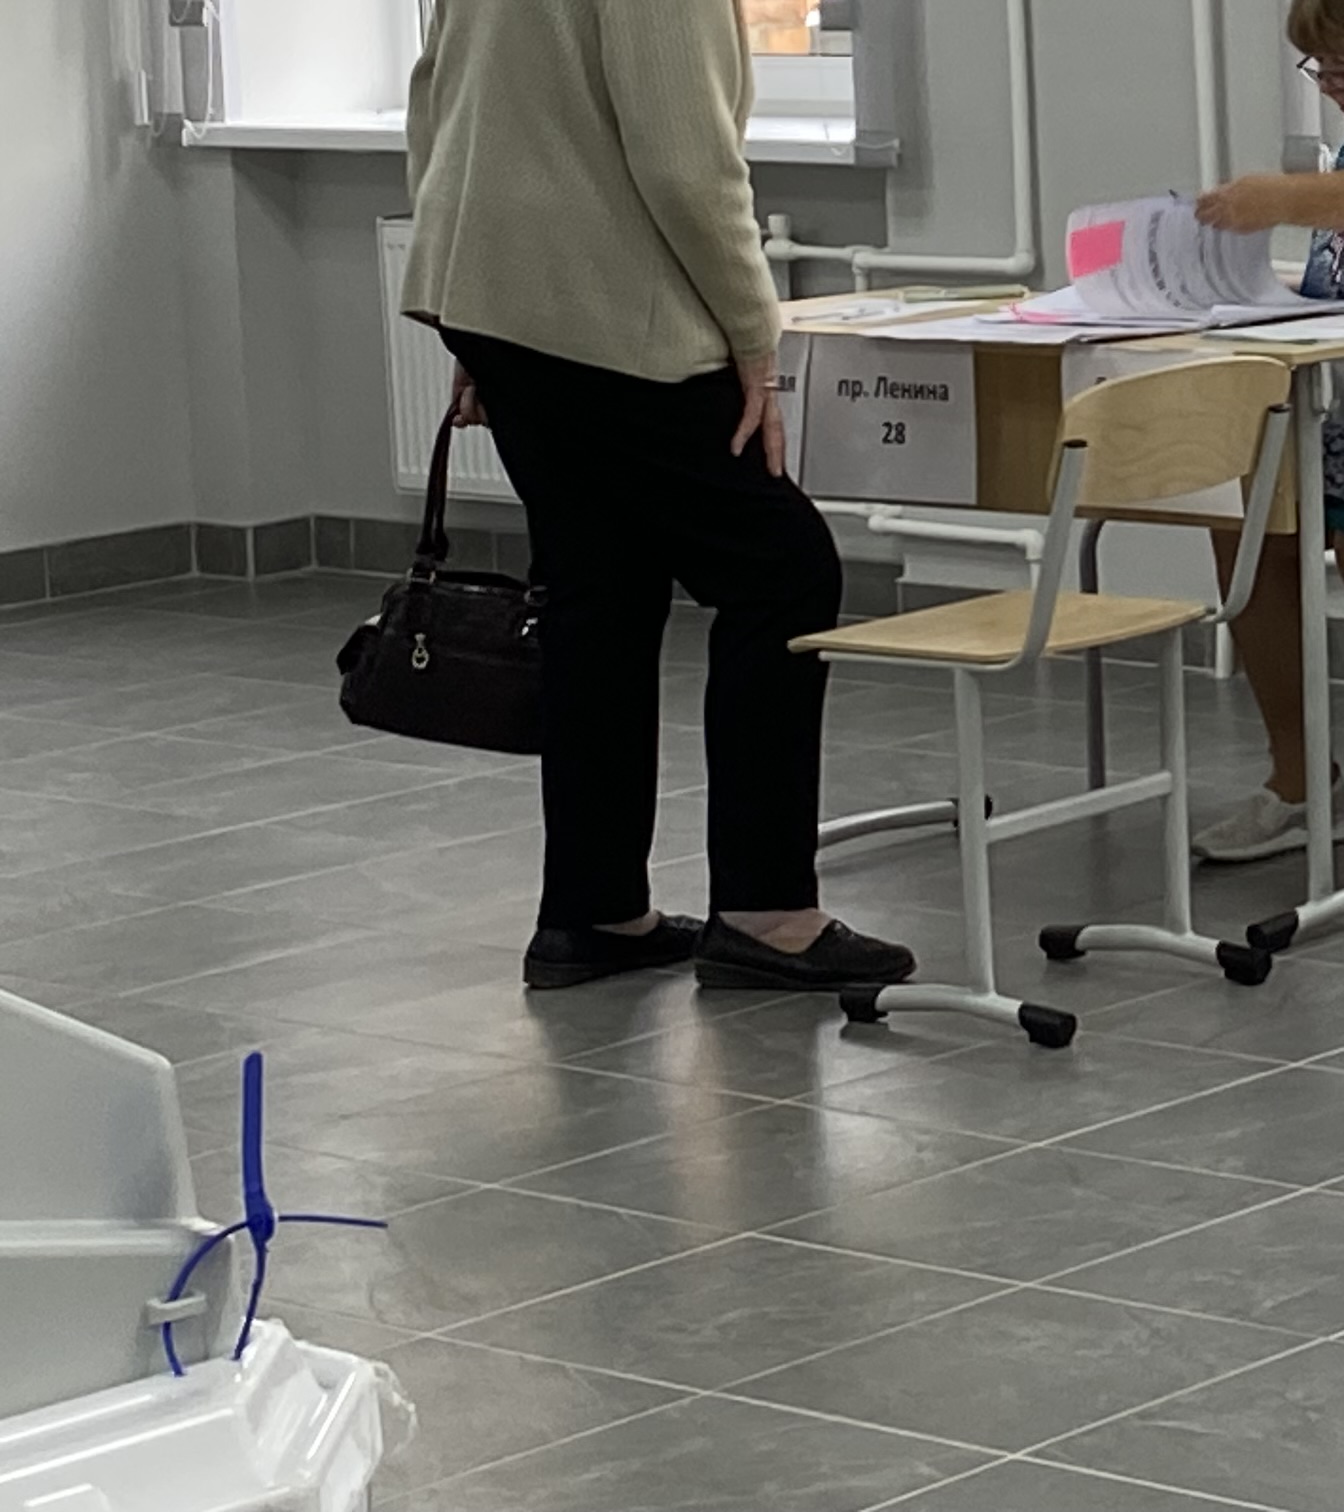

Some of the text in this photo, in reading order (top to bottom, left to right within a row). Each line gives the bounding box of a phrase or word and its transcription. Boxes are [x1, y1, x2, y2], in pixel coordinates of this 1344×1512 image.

[837, 375, 949, 402] пр. Ленина
[881, 421, 906, 444] 28
